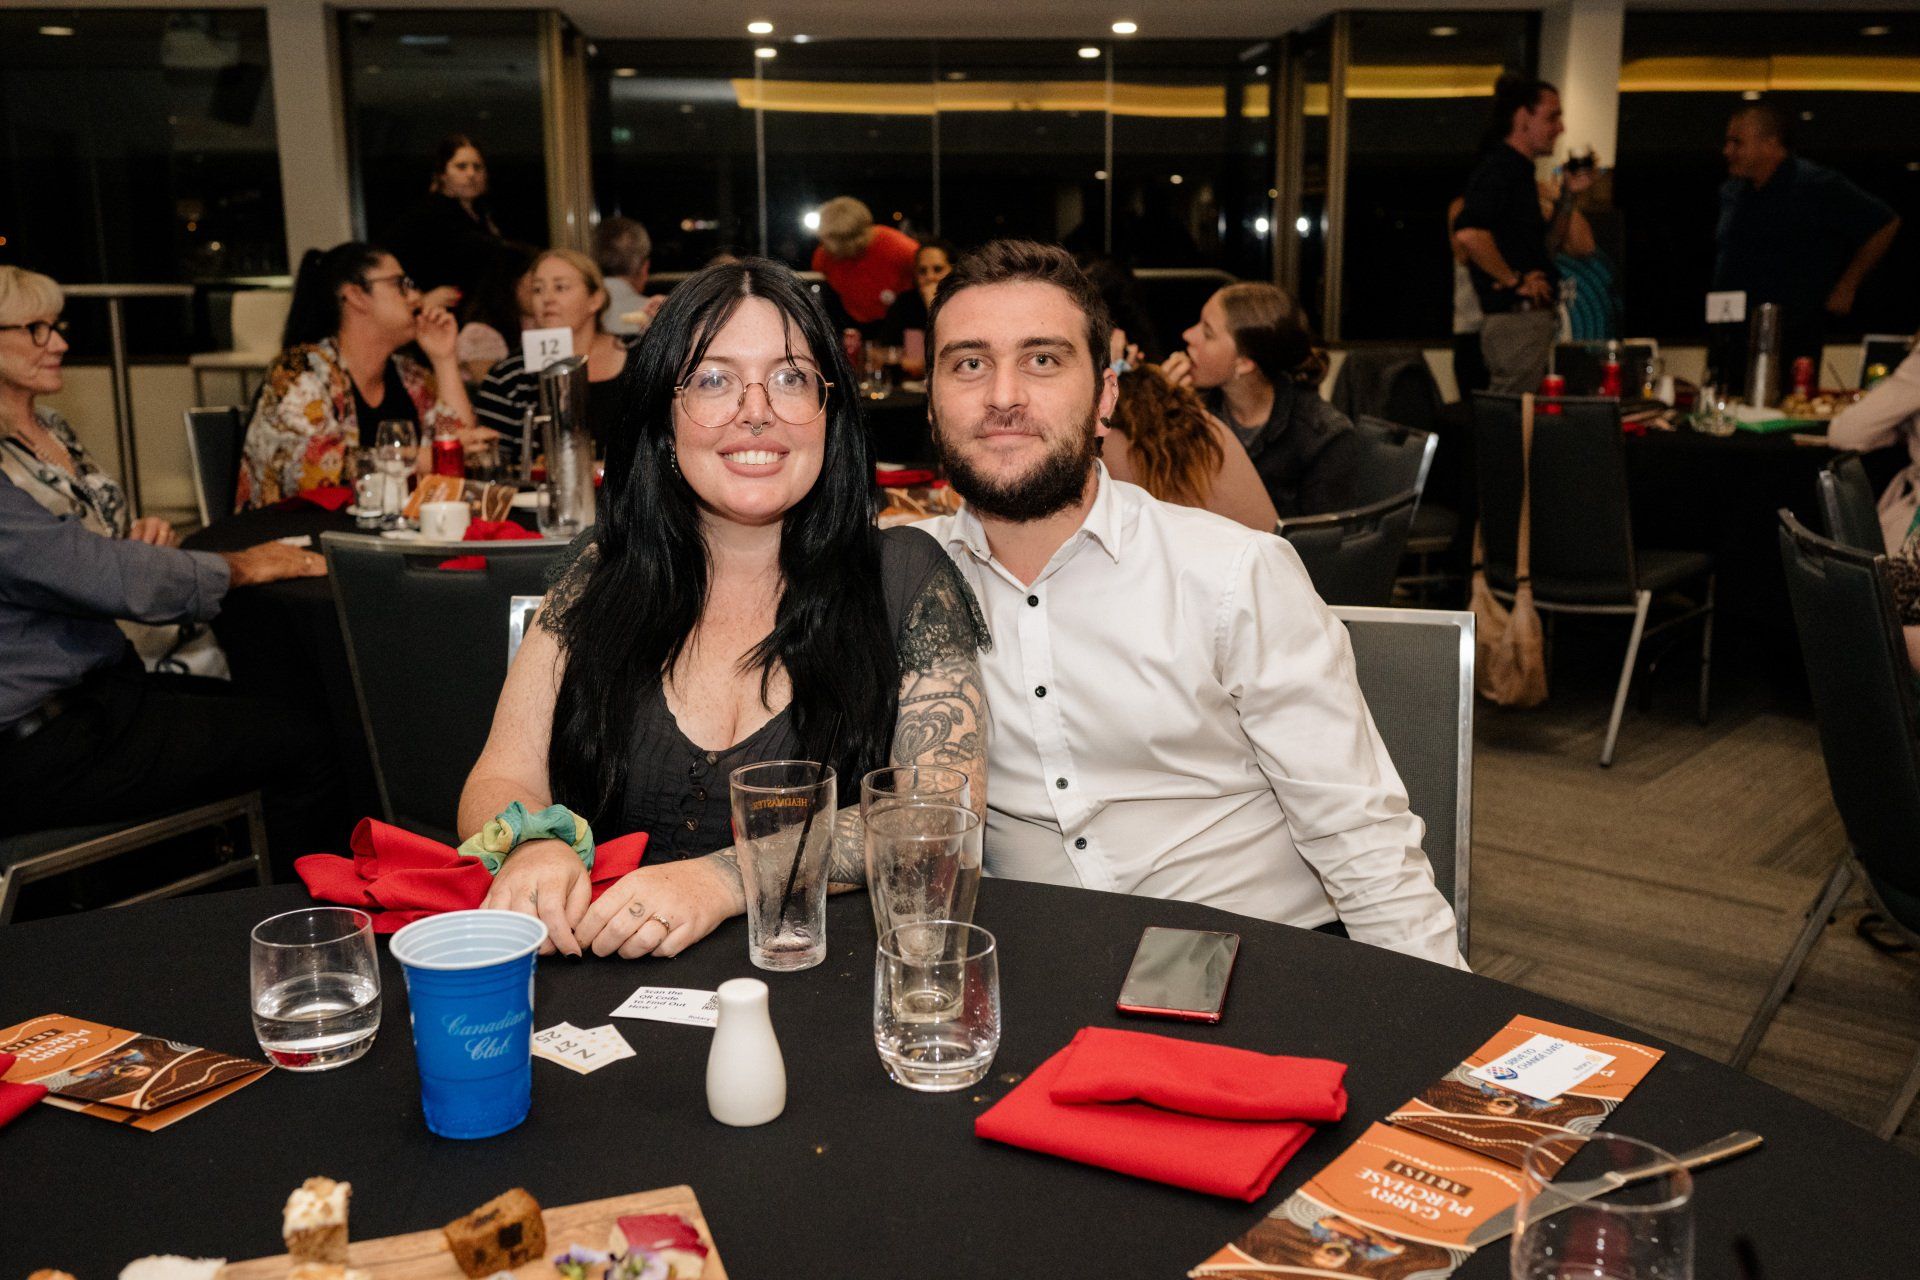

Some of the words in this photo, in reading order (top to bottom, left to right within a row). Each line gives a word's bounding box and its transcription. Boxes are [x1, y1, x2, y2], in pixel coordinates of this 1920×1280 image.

[539, 337, 560, 356] 12
[441, 1008, 528, 1036] Canadian
[464, 1032, 513, 1061] Club
[1355, 1166, 1475, 1218] PURCHASE
[1391, 1162, 1465, 1194] ARTIST
[1363, 1185, 1441, 1220] GARRY
